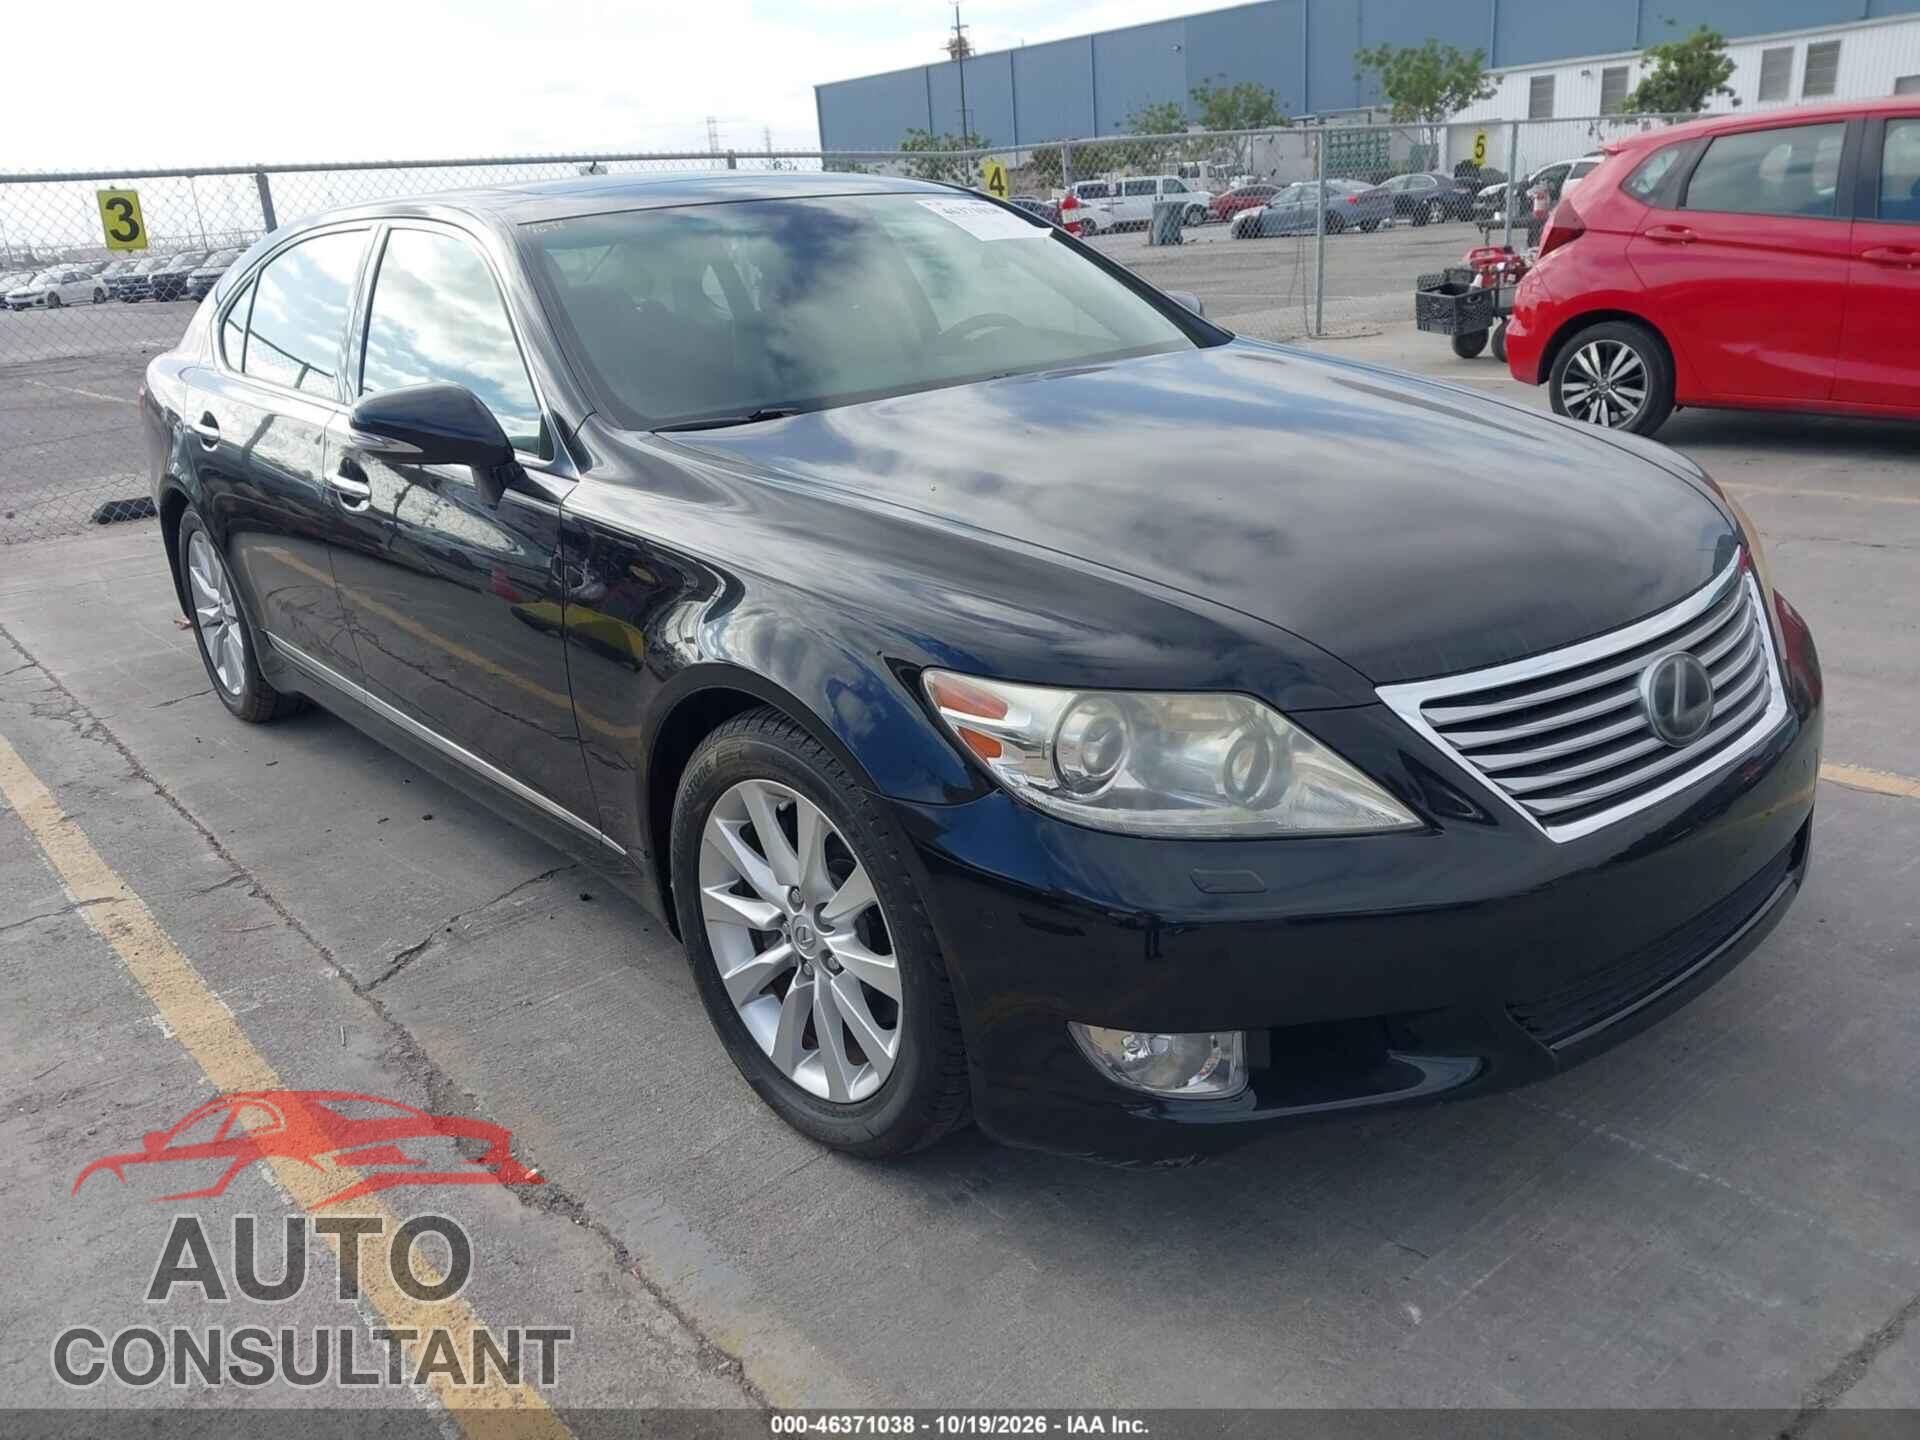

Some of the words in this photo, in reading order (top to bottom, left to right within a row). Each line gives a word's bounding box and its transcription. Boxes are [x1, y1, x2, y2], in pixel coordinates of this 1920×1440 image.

[1475, 135, 1485, 159] 5
[989, 166, 1005, 197] 4
[106, 197, 140, 242] 3
